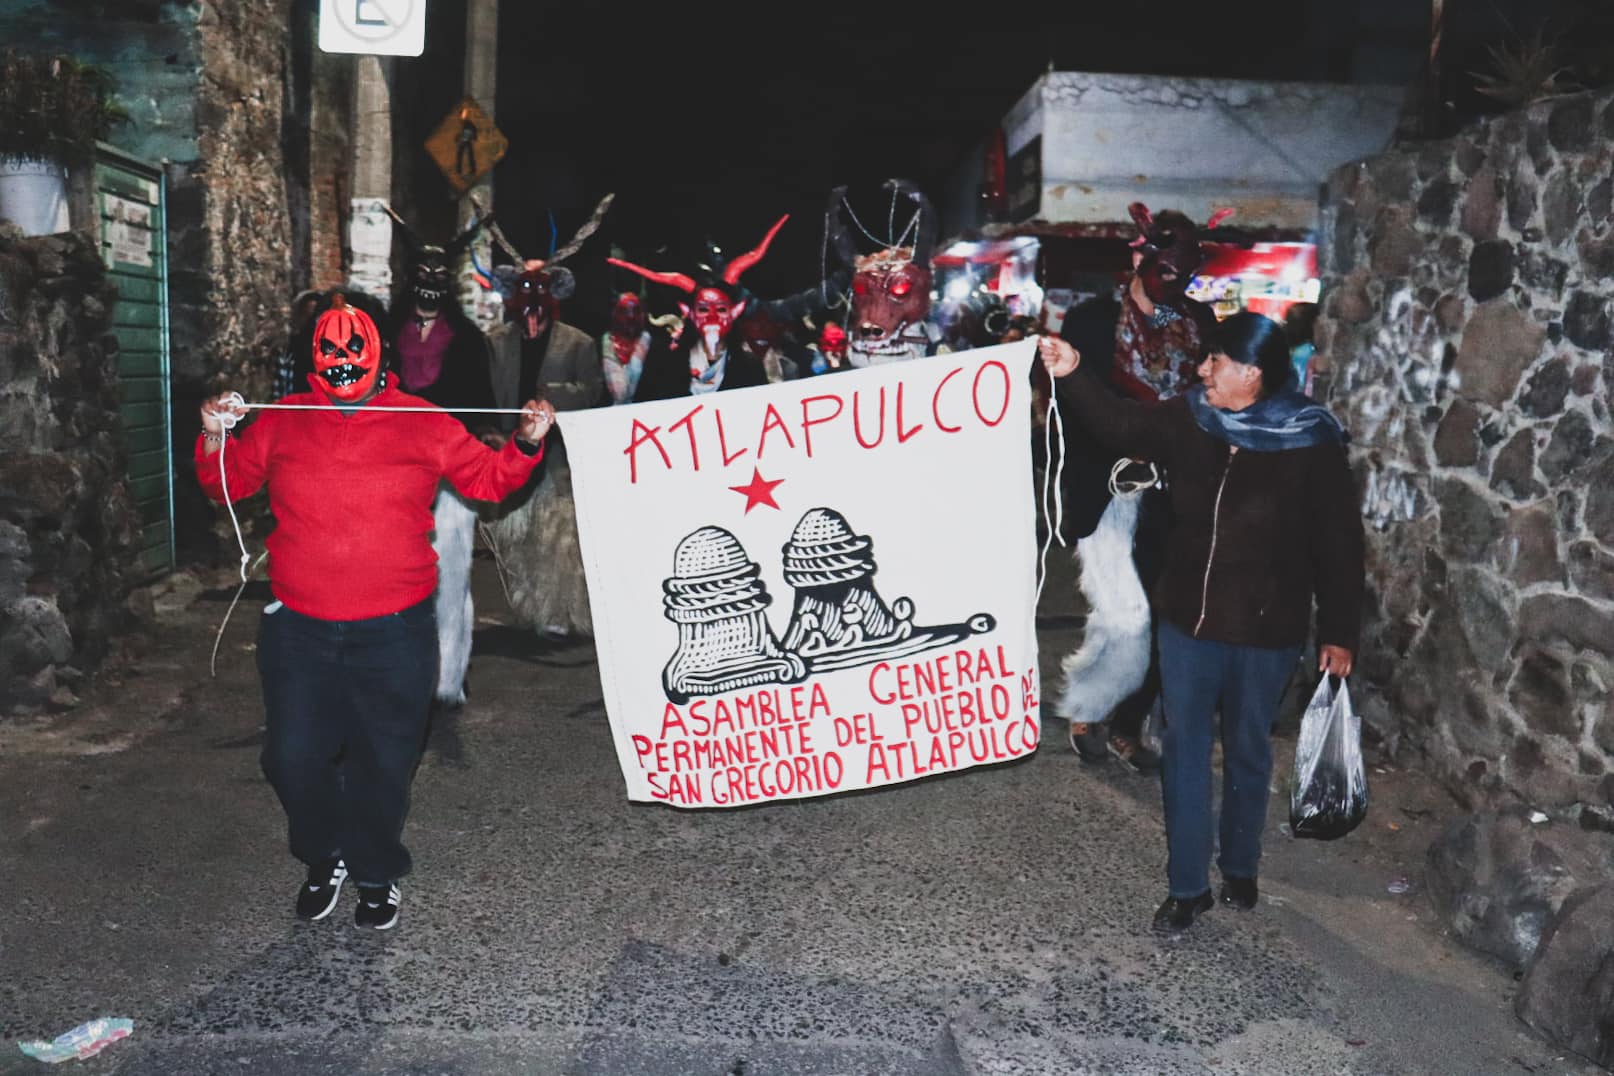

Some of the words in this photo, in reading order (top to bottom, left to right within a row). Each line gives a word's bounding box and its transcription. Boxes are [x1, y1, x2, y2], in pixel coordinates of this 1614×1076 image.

[623, 358, 1012, 484] ATLAPULCO
[631, 721, 812, 773] PERMANENTE
[833, 713, 885, 749] DEL
[900, 683, 1010, 739] PUEBLO
[660, 682, 831, 740] ASAMBLEA
[868, 644, 1015, 706] GENERAL
[647, 771, 702, 805] SAN
[710, 751, 845, 806] GREGORIO
[865, 714, 1039, 785] ATLAPULCO
